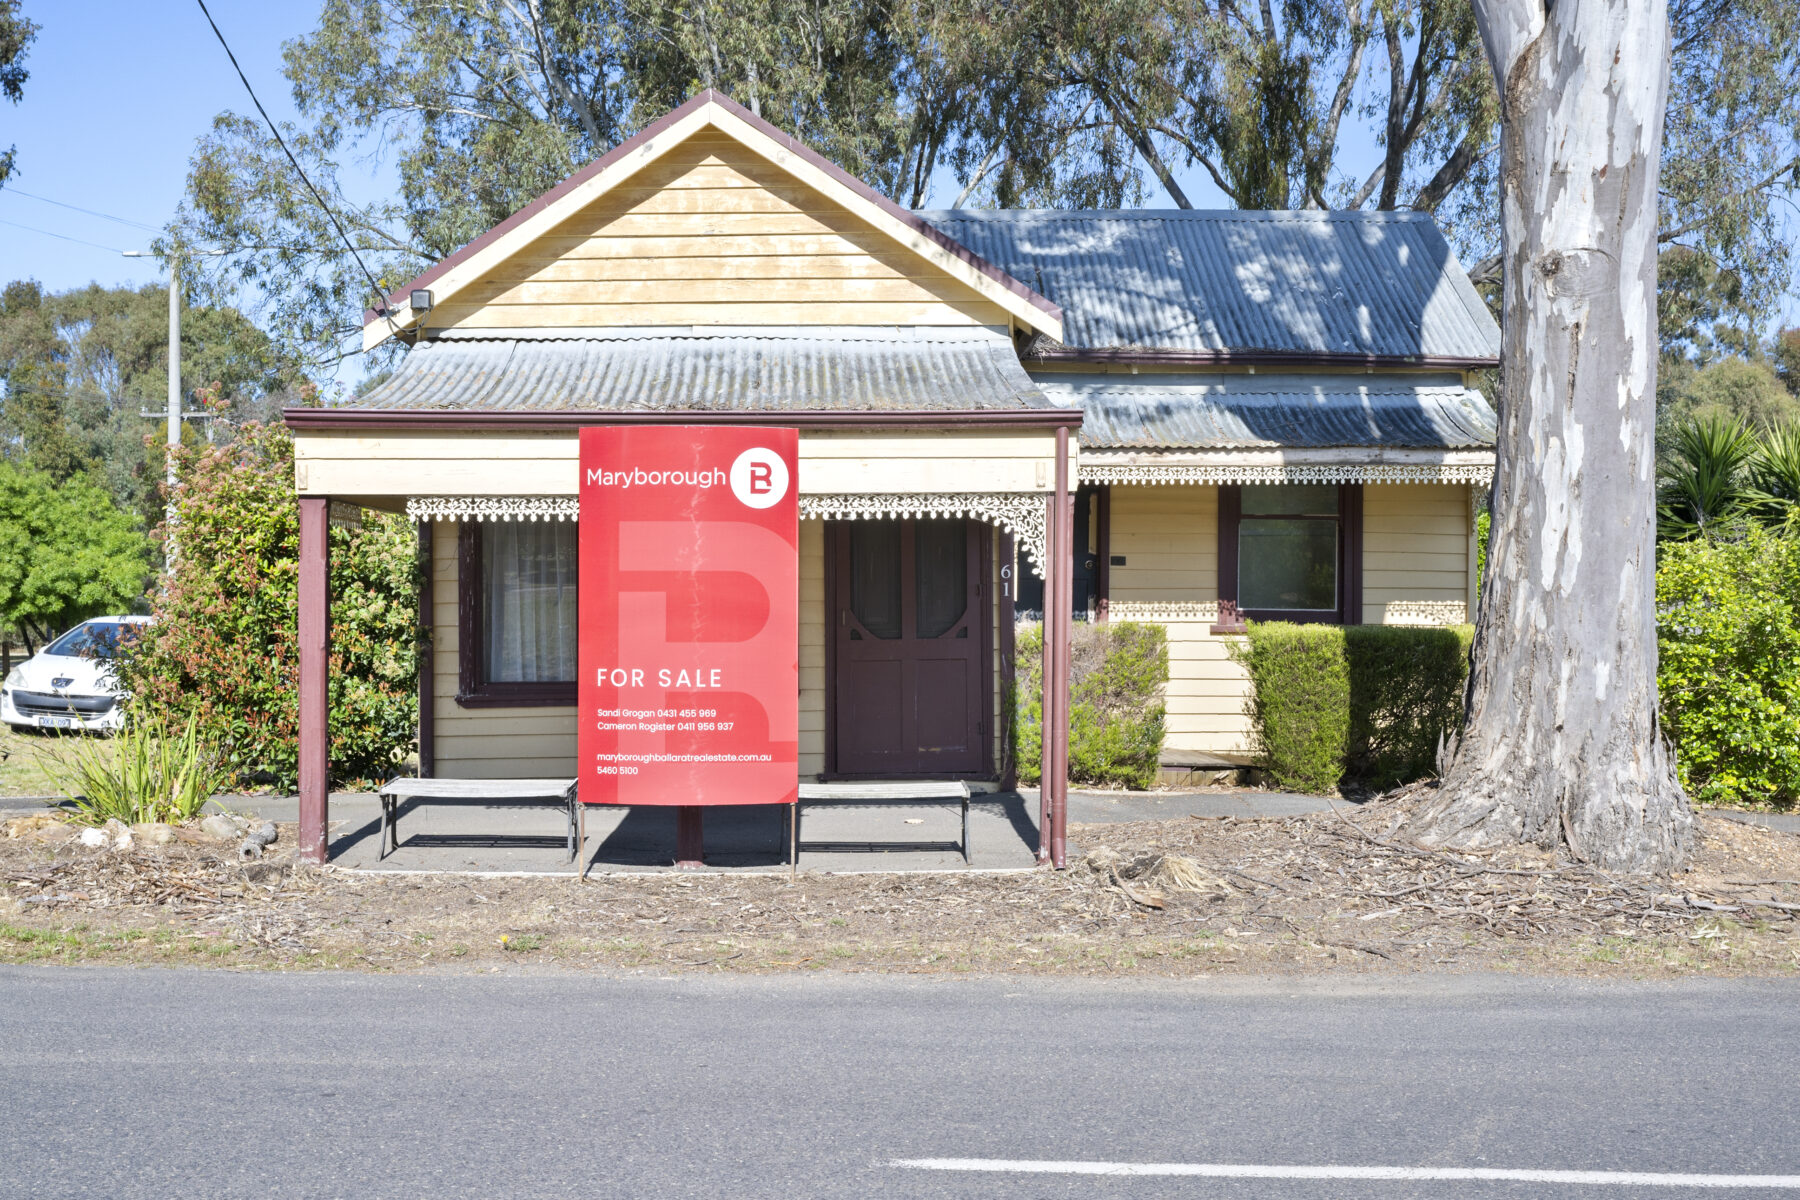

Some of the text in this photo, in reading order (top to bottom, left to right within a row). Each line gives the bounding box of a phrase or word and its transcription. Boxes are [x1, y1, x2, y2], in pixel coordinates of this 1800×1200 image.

[587, 467, 726, 488] Maryborough
[597, 668, 722, 687] FOR SALE
[597, 708, 717, 720] Sandi Grogan 0431 455 969
[597, 721, 734, 732] Cameron Rogister 0411 956 937
[597, 753, 772, 764] maryboroughballaratrealestate.com.au
[597, 766, 639, 775] 5460 5100
